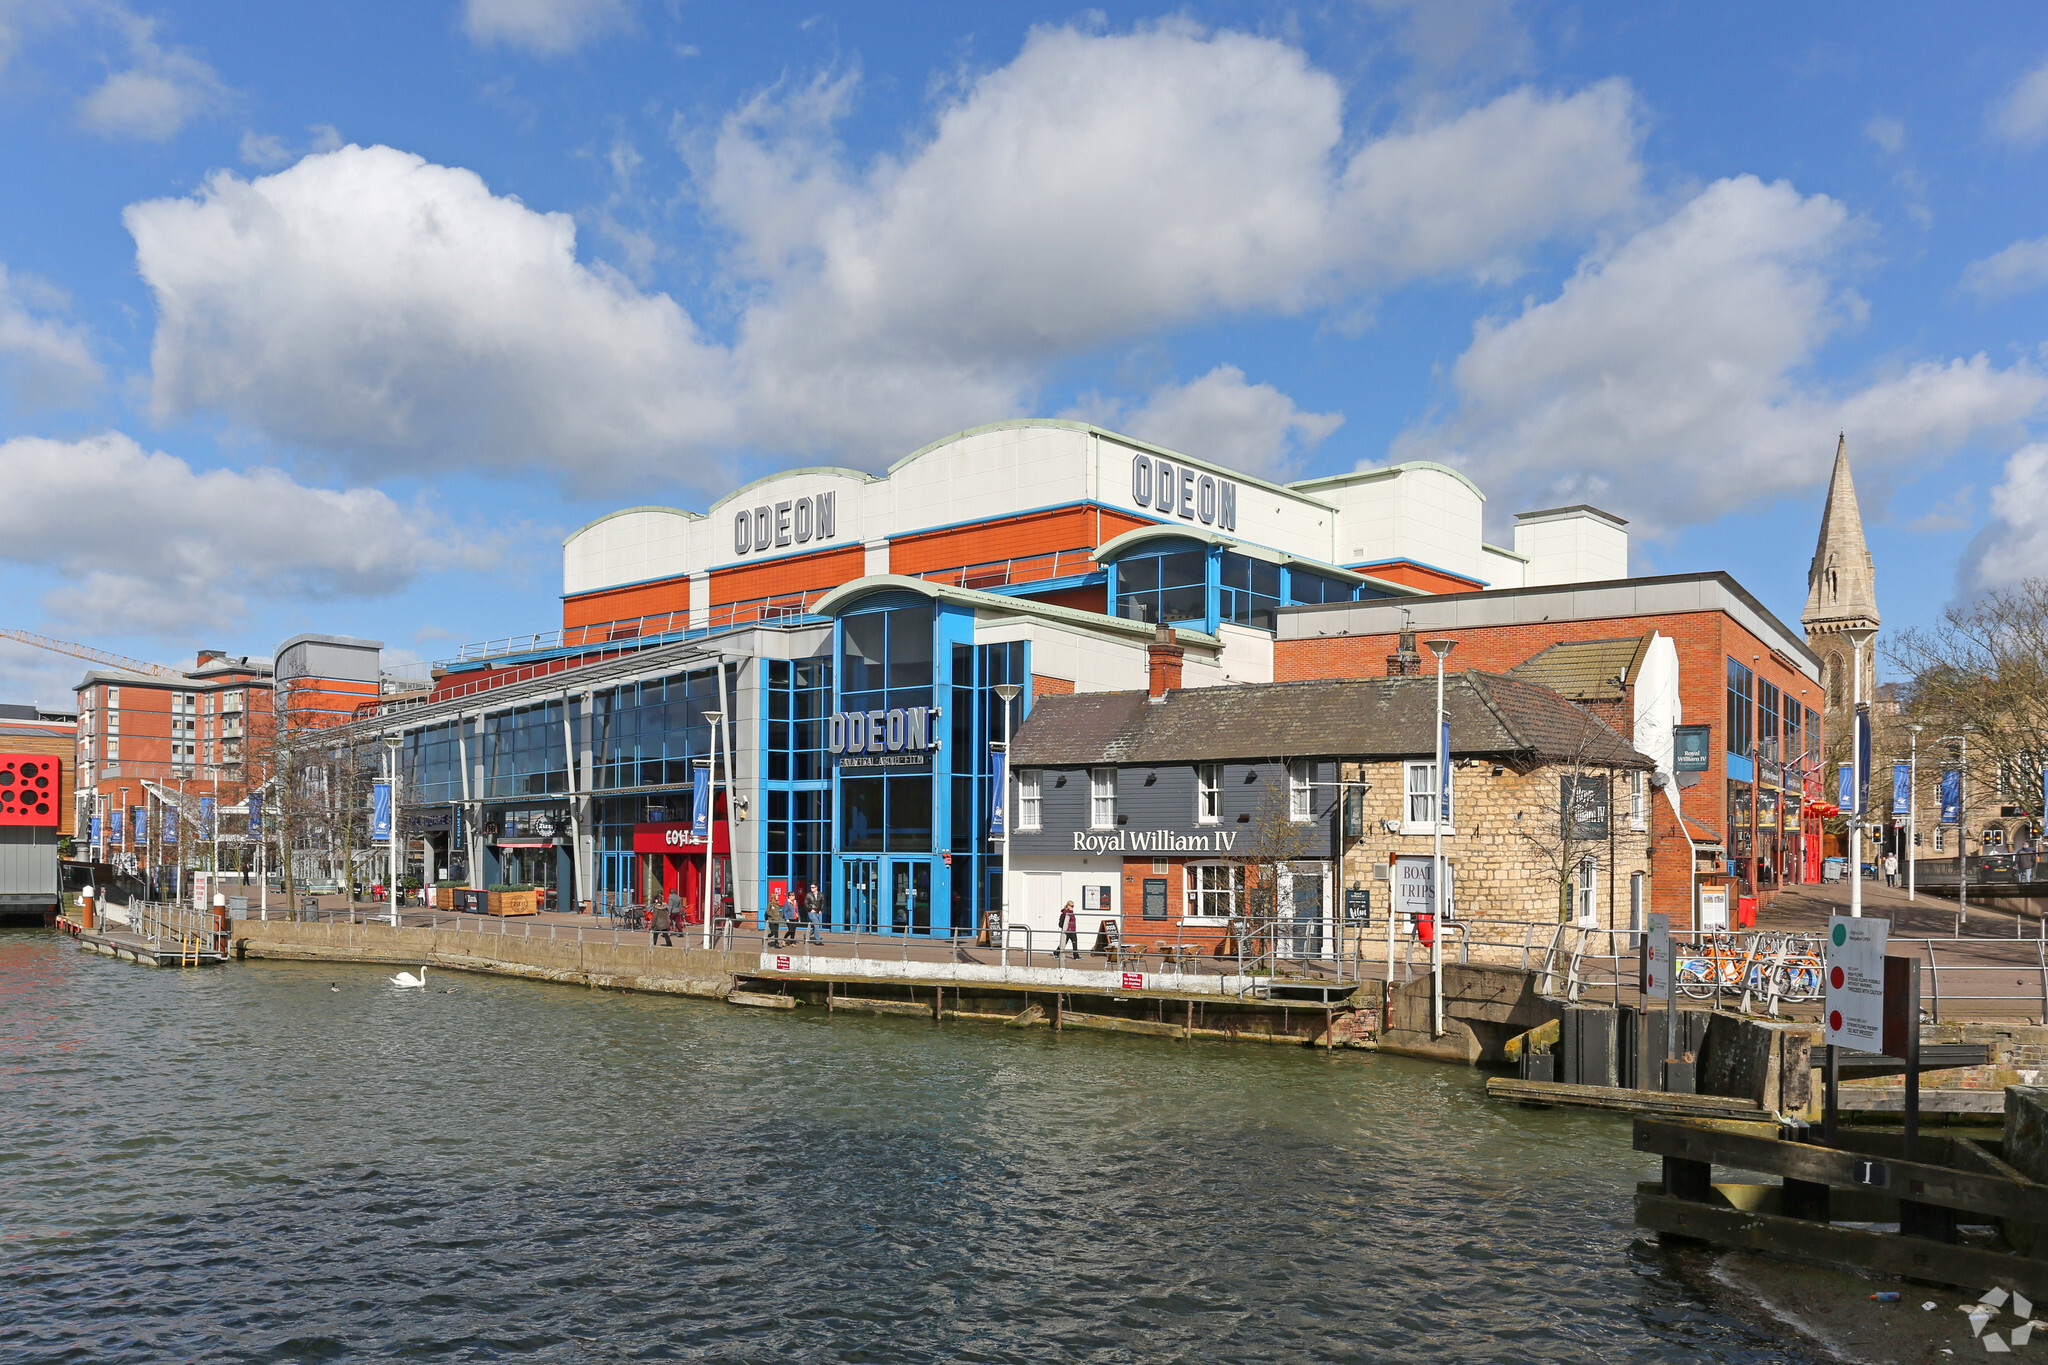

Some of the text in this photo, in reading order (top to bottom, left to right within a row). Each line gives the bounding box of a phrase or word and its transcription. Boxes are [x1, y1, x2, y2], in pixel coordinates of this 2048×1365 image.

[1132, 454, 1236, 532] ODEON
[735, 491, 835, 556] ODEON
[829, 706, 929, 754] ODEON
[1073, 830, 1238, 856] Royal William IV
[1400, 884, 1435, 899] TRIPS
[1404, 866, 1433, 880] BOAT
